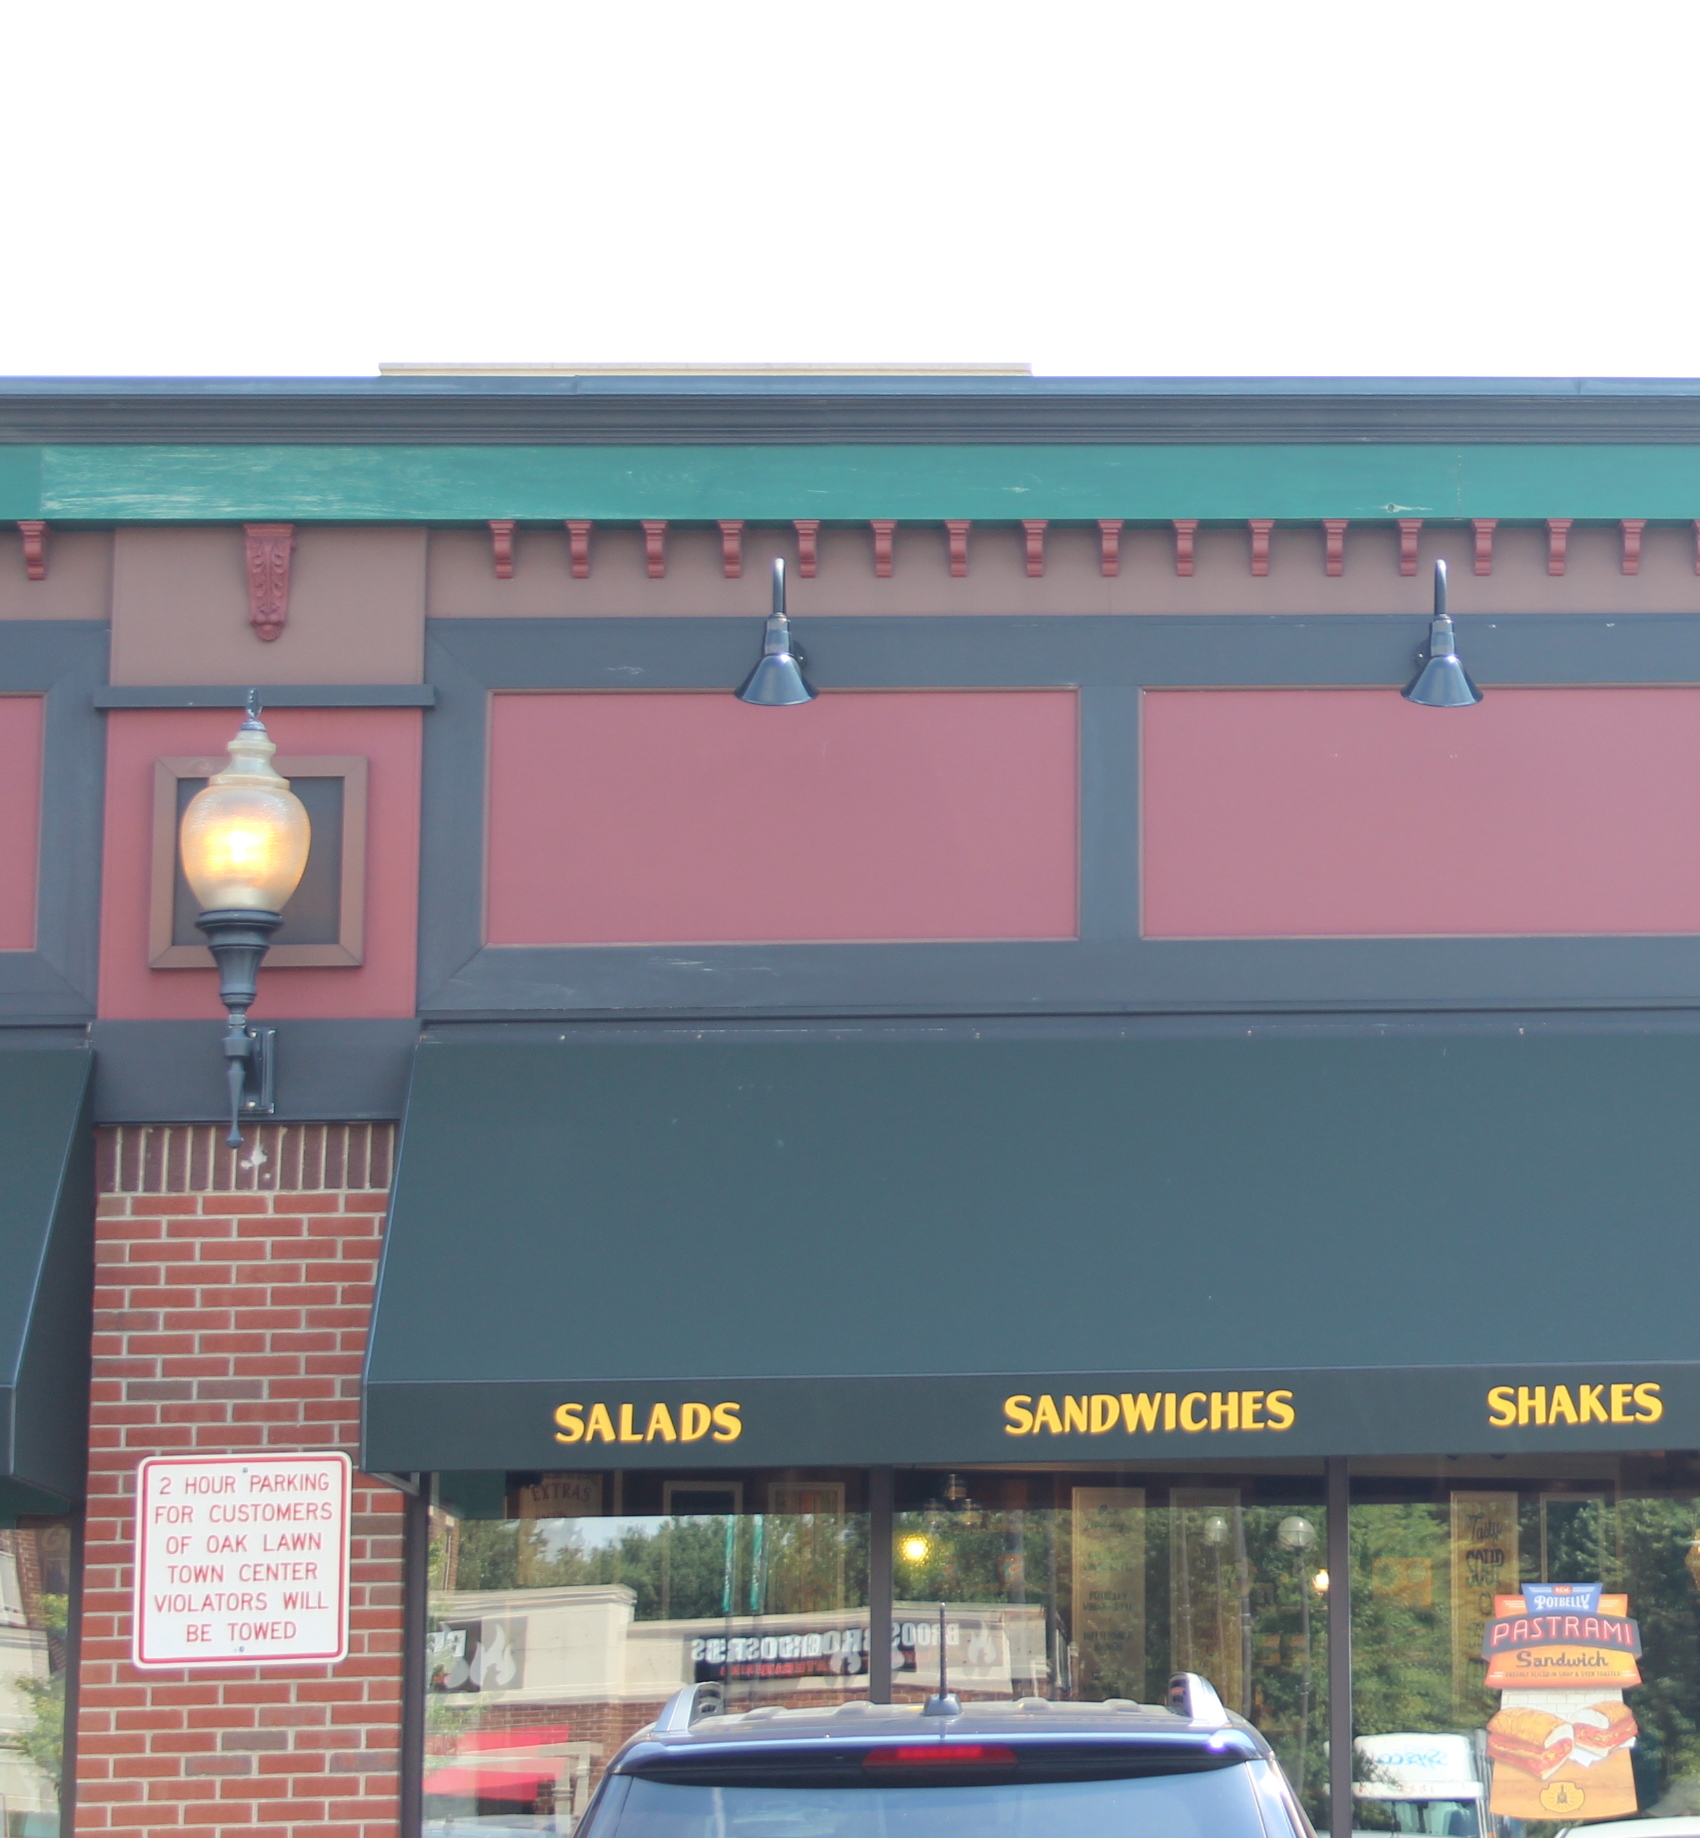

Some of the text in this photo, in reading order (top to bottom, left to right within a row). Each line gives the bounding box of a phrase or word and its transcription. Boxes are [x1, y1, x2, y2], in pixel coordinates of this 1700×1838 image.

[1004, 1389, 1295, 1435] SANDWICHES
[1487, 1382, 1663, 1426] SHAKES
[554, 1402, 742, 1443] SALADS
[159, 1473, 330, 1495] 2 HOUR PARKING
[531, 1482, 592, 1502] EXTRAS
[154, 1502, 333, 1524] FOR CUSTOMERS
[166, 1532, 322, 1554] OF OAK LAWN
[167, 1562, 319, 1584] TOWN CENTER
[154, 1591, 329, 1613] VIOLATORS WILL
[1534, 1594, 1591, 1610] POTBELLY
[186, 1621, 297, 1643] BE TOWED
[1491, 1616, 1634, 1646] PASTRAMI
[1516, 1651, 1609, 1668] Sandwich
